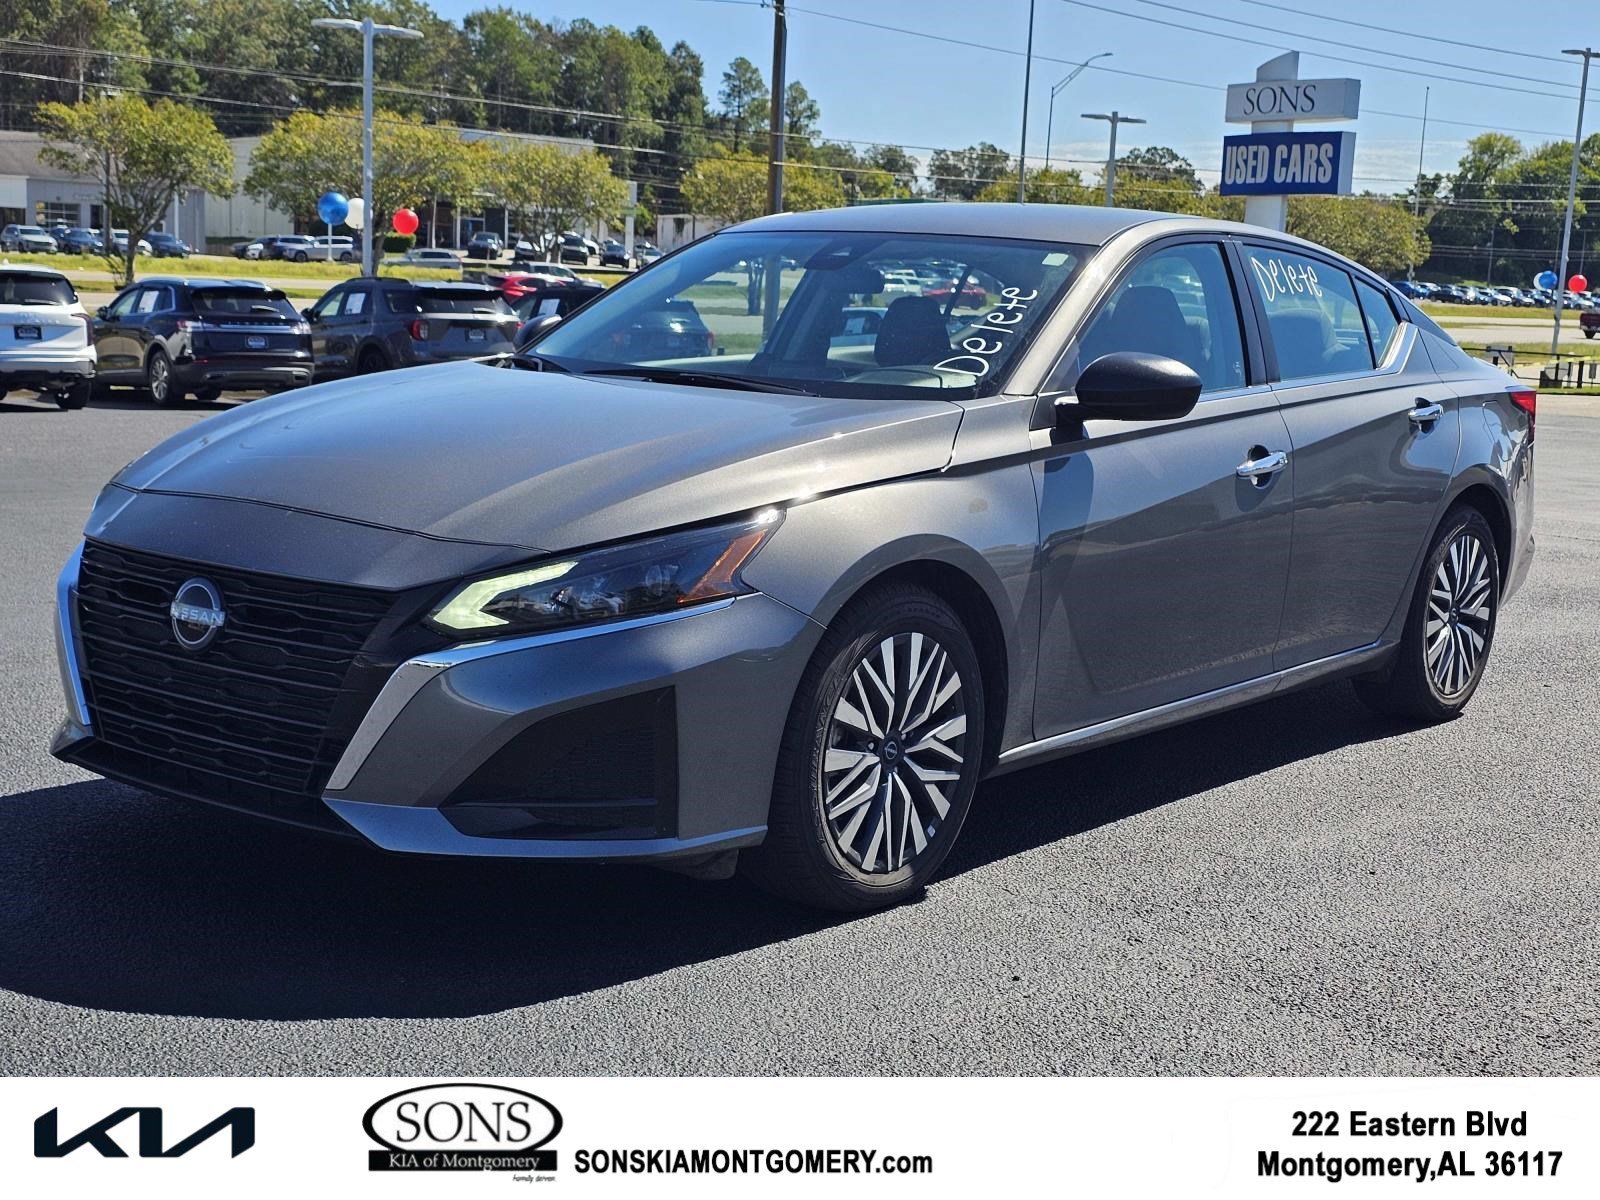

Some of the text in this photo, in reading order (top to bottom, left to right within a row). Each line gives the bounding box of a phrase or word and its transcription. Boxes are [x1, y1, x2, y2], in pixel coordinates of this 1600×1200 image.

[1243, 84, 1317, 116] SONS
[1224, 142, 1334, 185] USED CARS
[1251, 257, 1323, 302] Delete
[933, 287, 1038, 377] Delete
